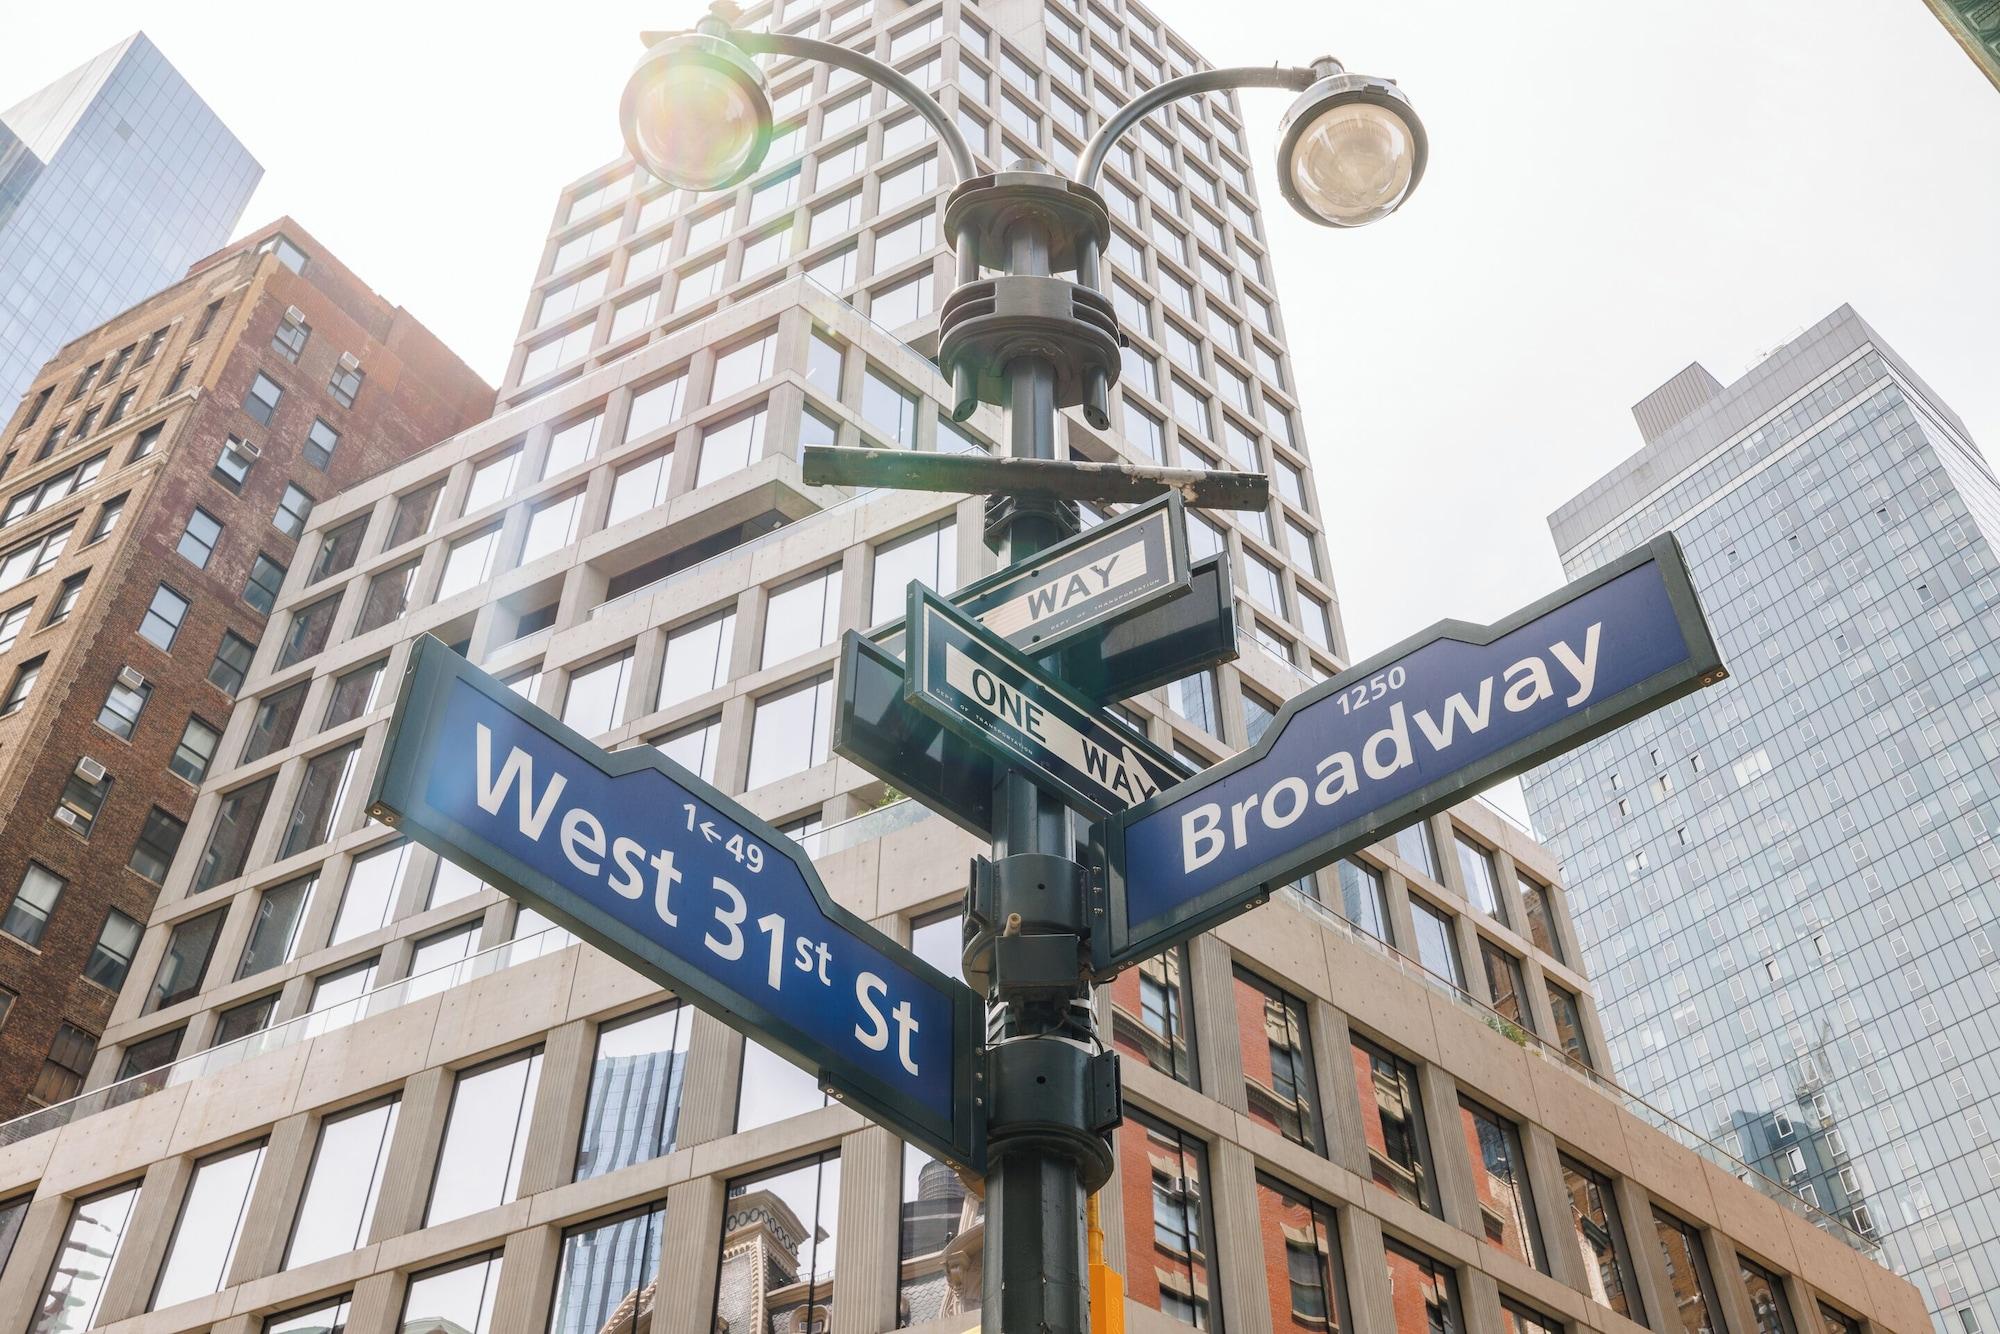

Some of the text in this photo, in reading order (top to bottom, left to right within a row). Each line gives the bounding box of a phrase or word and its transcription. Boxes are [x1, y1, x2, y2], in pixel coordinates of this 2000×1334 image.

[1028, 554, 1121, 620] WAY
[972, 668, 1046, 743] ONE
[1337, 666, 1406, 715] 1250
[1181, 622, 1602, 874] Broadway
[476, 722, 919, 1076] West 31st St
